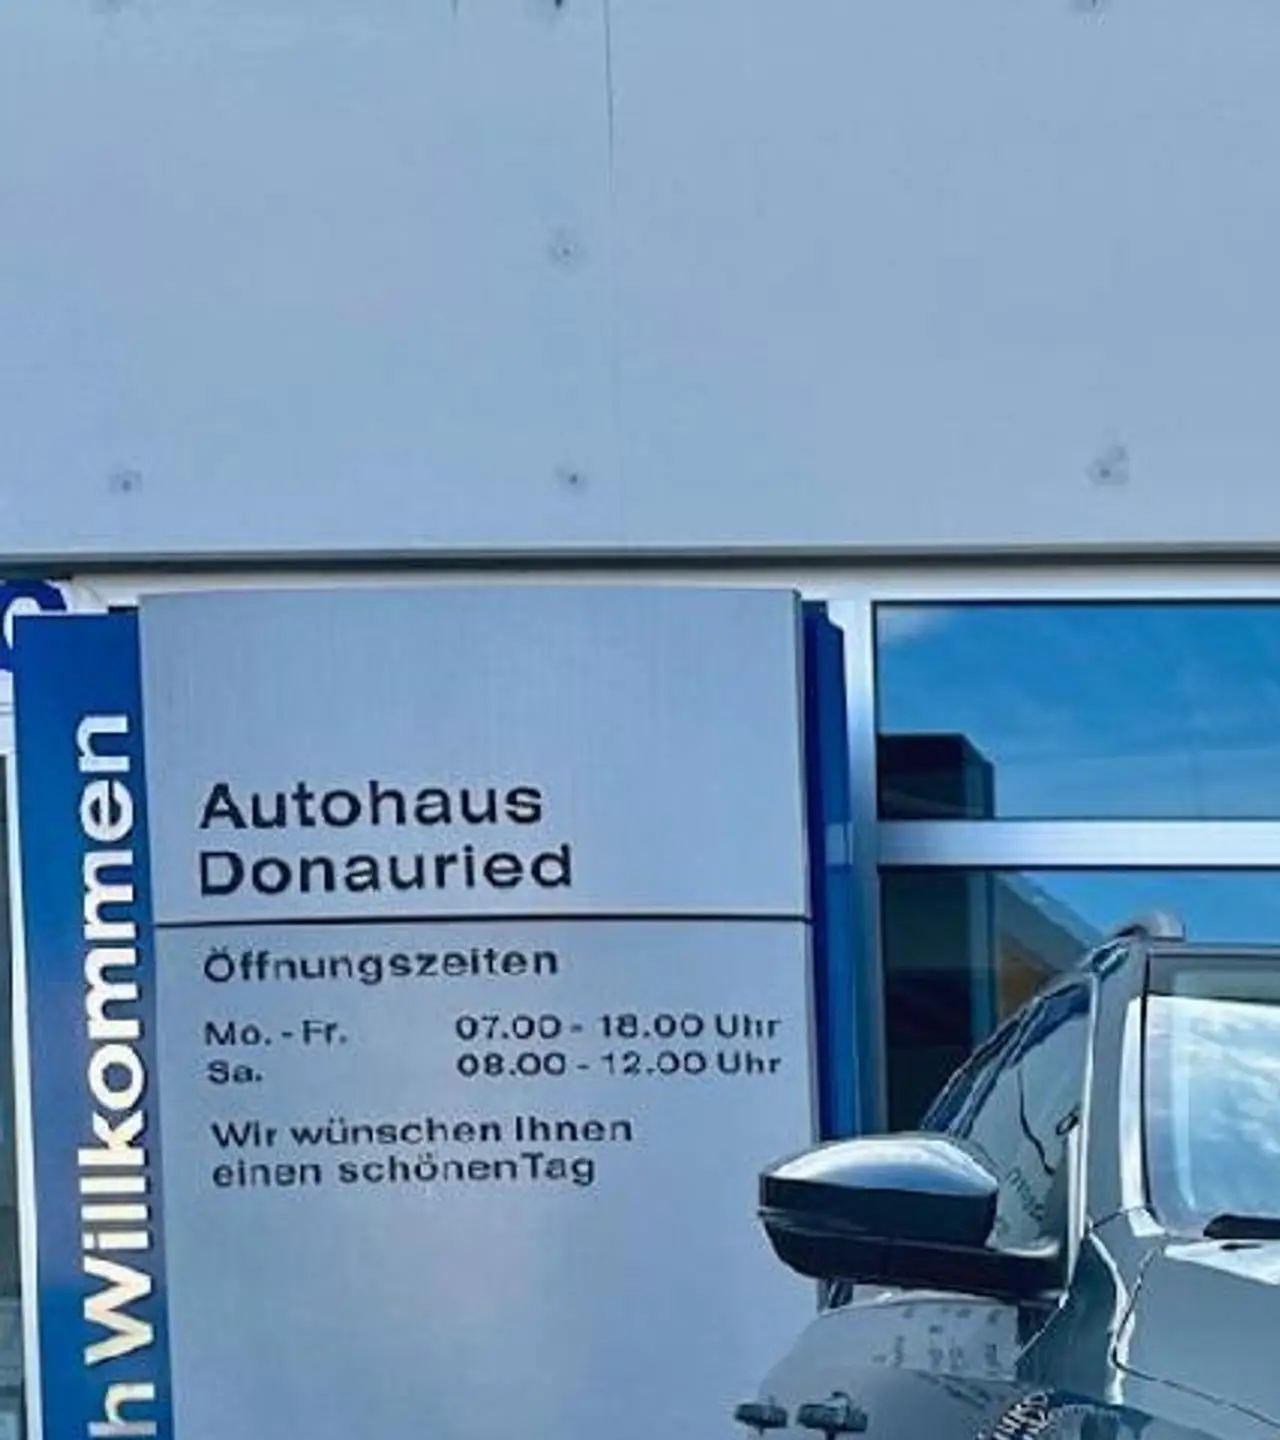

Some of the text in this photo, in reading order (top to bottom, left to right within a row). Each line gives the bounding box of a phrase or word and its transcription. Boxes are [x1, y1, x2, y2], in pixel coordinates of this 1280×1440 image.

[199, 779, 542, 830] Autohaus
[199, 843, 572, 897] Donauried
[203, 945, 559, 986] Öffnungszeiten
[77, 712, 155, 1366] Willkommen
[204, 1020, 271, 1046] Mo.
[302, 1019, 347, 1045] Fr.
[455, 1015, 562, 1041] 07.00
[601, 1013, 704, 1039] 18.00
[715, 1014, 781, 1039] Uhr
[208, 1060, 263, 1085] Sa.
[456, 1052, 566, 1077] 08.00
[602, 1050, 707, 1075] 12.00
[717, 1051, 781, 1075] Uhr
[211, 1116, 632, 1149] Wir wünschen Ihnen
[212, 1158, 322, 1188] einen
